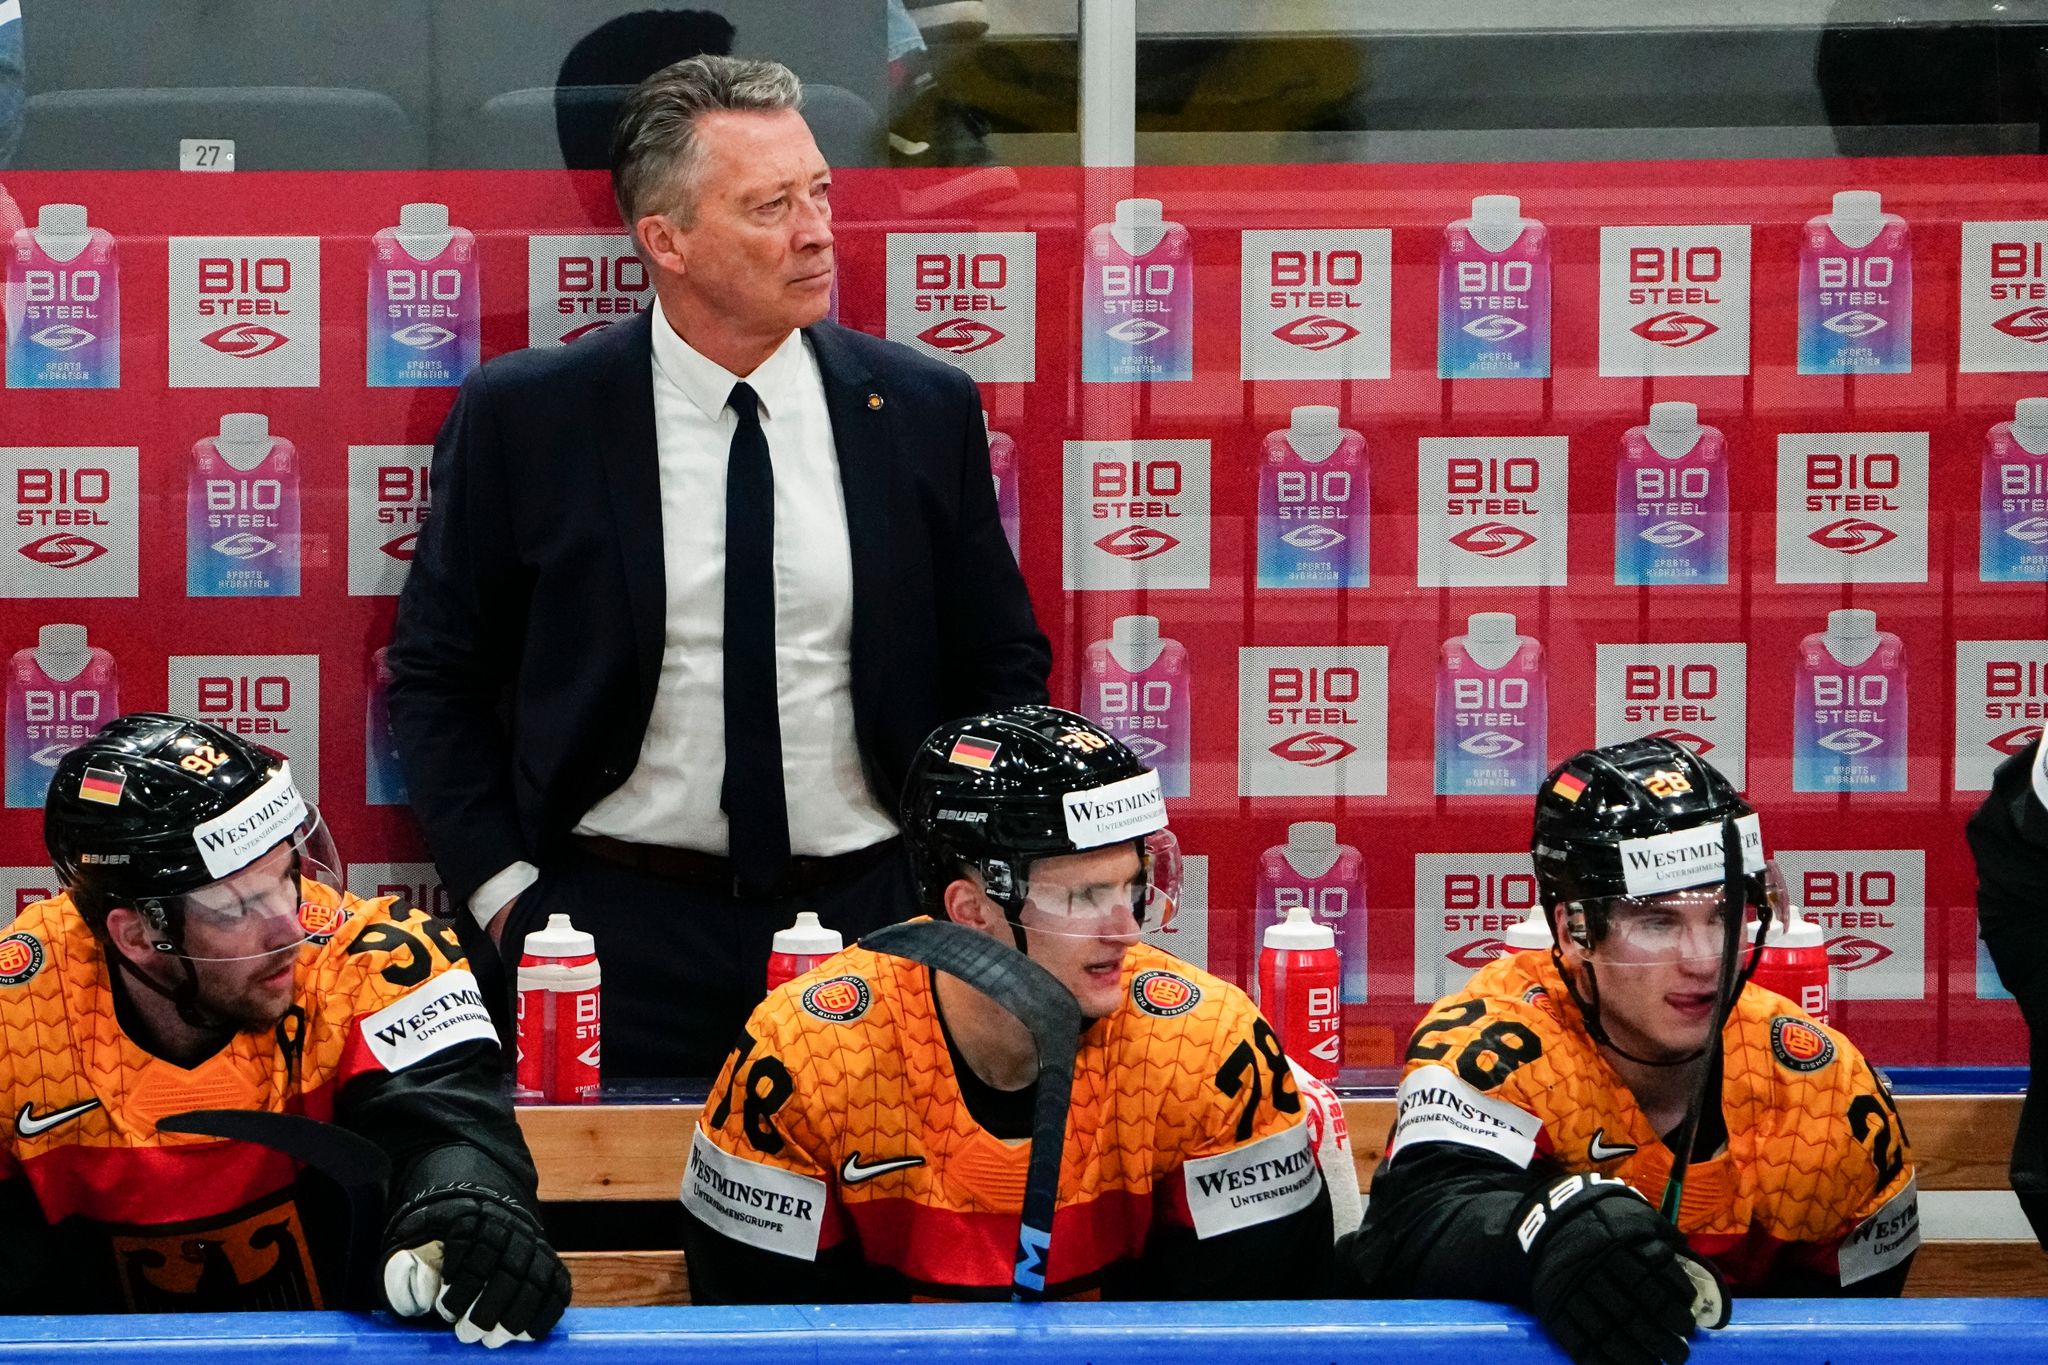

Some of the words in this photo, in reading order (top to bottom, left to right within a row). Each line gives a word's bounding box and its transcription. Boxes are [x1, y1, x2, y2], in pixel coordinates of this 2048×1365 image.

[195, 146, 221, 167] 27
[558, 256, 650, 292] BIO
[916, 254, 1007, 290] BIO
[1271, 250, 1362, 287] BIO
[1629, 247, 1722, 283] BIO
[1818, 256, 1894, 288] BIO
[1991, 242, 2042, 278] BI
[26, 270, 100, 301] BIO
[199, 258, 291, 294] BIO
[387, 270, 461, 301] BIO
[1102, 265, 1175, 296] BIO
[1458, 261, 1532, 292] BIO
[1990, 283, 2046, 300] STE
[199, 299, 291, 315] STEEL
[388, 305, 460, 318] STEEL
[915, 294, 1007, 311] STEEL
[1103, 300, 1173, 314] STEEL
[1270, 291, 1362, 308] STEEL
[1459, 296, 1529, 309] STEEL
[1629, 288, 1721, 304] STEEL
[1819, 291, 1890, 306] STEEL
[27, 305, 98, 319] STEEL
[17, 468, 109, 504] BIO
[378, 466, 428, 502] BI
[1093, 460, 1182, 497] BIO
[1448, 457, 1540, 493] BIO
[1635, 468, 1709, 499] BIO
[1806, 453, 1899, 489] BIO
[2001, 464, 2048, 495] BI
[206, 479, 281, 510] BIO
[1277, 472, 1350, 502] BIO
[1806, 494, 1899, 511] STEEL
[17, 509, 109, 526] STEEL
[208, 514, 279, 528] STEEL
[1093, 502, 1181, 518] STEEL
[1279, 506, 1349, 519] STEEL
[1447, 499, 1539, 515] STEEL
[1637, 502, 1707, 516] STEEL
[2003, 499, 2048, 512] STE
[198, 676, 290, 713] BIO
[1268, 667, 1359, 703] BIO
[1454, 678, 1528, 709] BIO
[1625, 664, 1718, 700] BIO
[1813, 675, 1888, 707] BIO
[1986, 661, 2048, 697] BI
[26, 690, 99, 721] BIO
[1100, 681, 1171, 712] BIO
[1101, 716, 1169, 730] STEEL
[1268, 708, 1358, 725] STEEL
[1456, 712, 1526, 727] STEEL
[1625, 705, 1717, 721] STEEL
[1815, 709, 1886, 723] STEEL
[26, 724, 97, 739] STEEL
[1059, 731, 1108, 753] 78
[180, 744, 230, 777] 92
[1643, 770, 1693, 799] 28
[200, 784, 299, 852] WESTMINST
[1628, 831, 1759, 870] WESTMINTER
[1275, 887, 1348, 918] BIO
[1445, 874, 1536, 909] BIO
[1803, 871, 1895, 907] BIO
[1444, 915, 1526, 932] STEE
[1803, 912, 1895, 929] STEEL
[1308, 985, 1340, 1016] BI
[1406, 998, 1543, 1091] 28
[711, 1027, 796, 1155] 78
[1215, 1017, 1301, 1142] 78
[690, 1145, 813, 1221] WESTMINSTER
